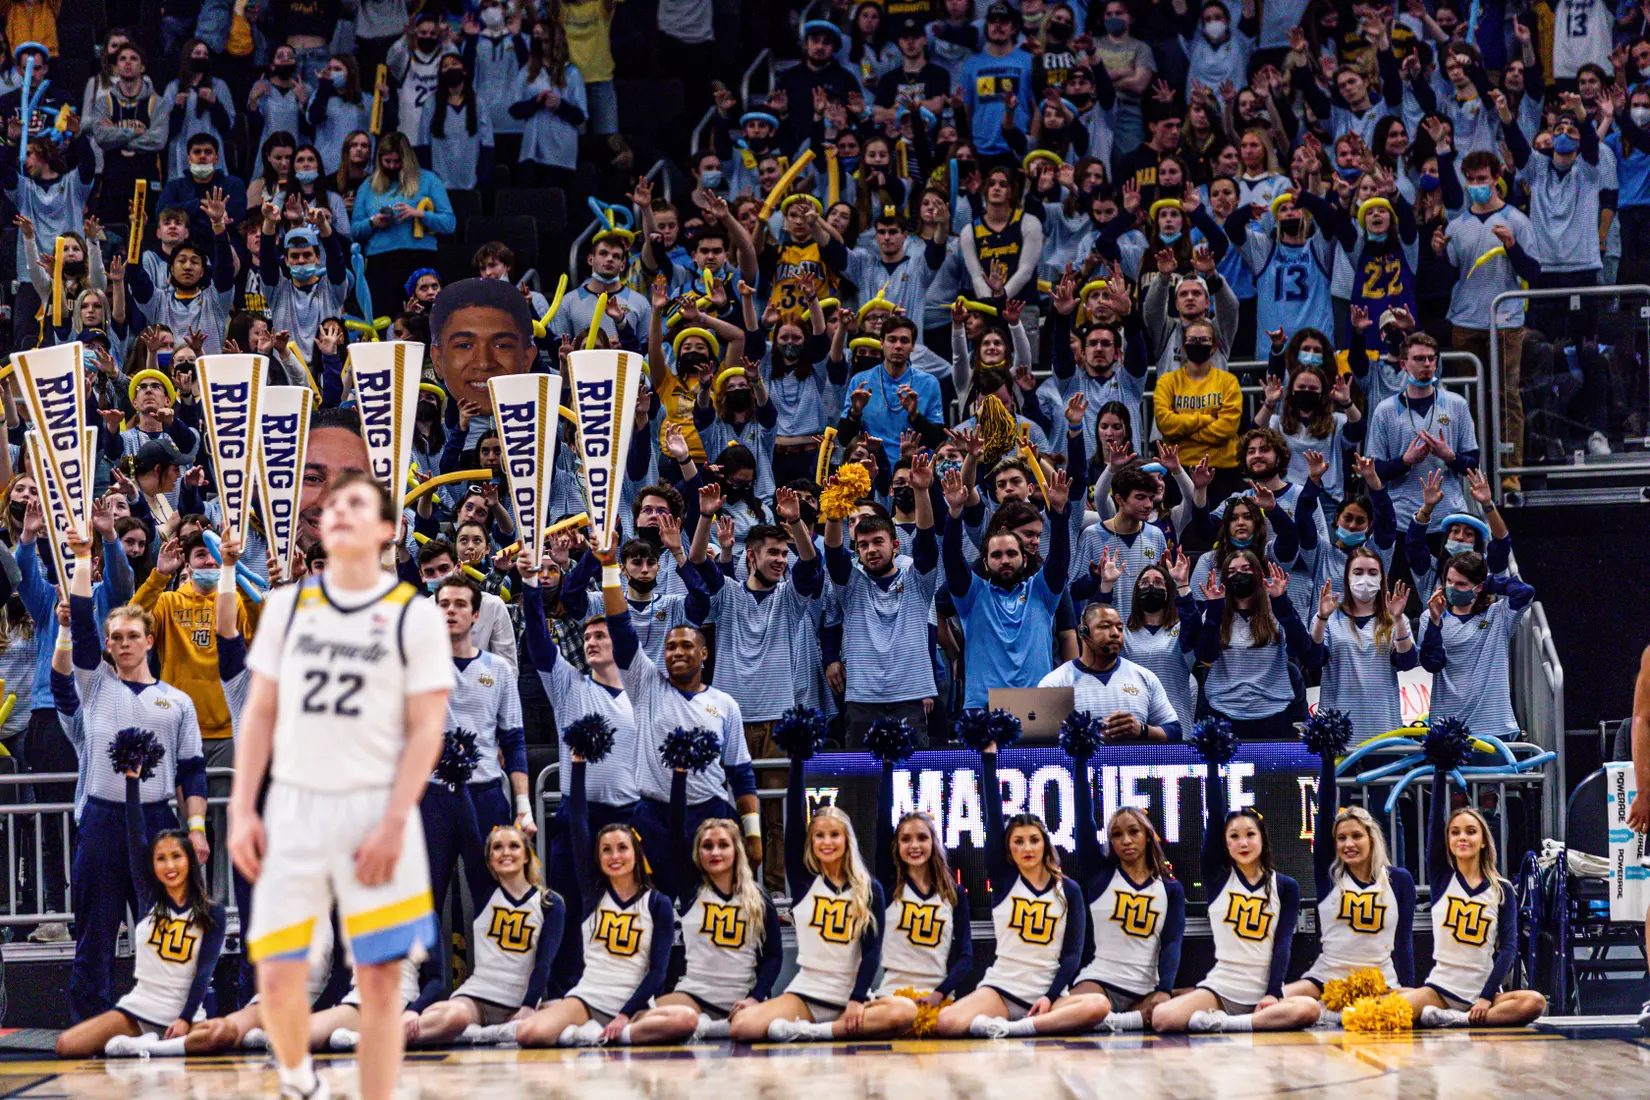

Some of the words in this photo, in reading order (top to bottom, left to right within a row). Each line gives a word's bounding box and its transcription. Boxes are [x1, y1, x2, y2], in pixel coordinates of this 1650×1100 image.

[1276, 265, 1307, 301] 13
[1362, 257, 1403, 299] 22
[210, 381, 249, 459] RING
[356, 369, 391, 447] RING
[576, 379, 613, 457] RING
[35, 371, 78, 451] RING
[60, 459, 84, 521] OUT
[261, 413, 298, 489] RING
[499, 401, 535, 477] RING
[223, 469, 243, 532] OUT
[515, 487, 535, 549] OUT
[588, 467, 608, 531] OUT
[271, 499, 292, 561] OUT
[303, 669, 364, 716] 22
[1617, 771, 1626, 824] POWERADE
[1616, 848, 1625, 899] POWERADE
[487, 906, 536, 953] MU
[595, 909, 643, 957] MU
[699, 902, 747, 949] MU
[808, 895, 857, 944] MU
[897, 899, 946, 947] MU
[1008, 895, 1058, 946] MU
[1110, 889, 1160, 939] MU
[1223, 891, 1274, 942] MU
[1337, 889, 1387, 935] MU
[1442, 894, 1493, 947] MU
[148, 917, 197, 964] MU
